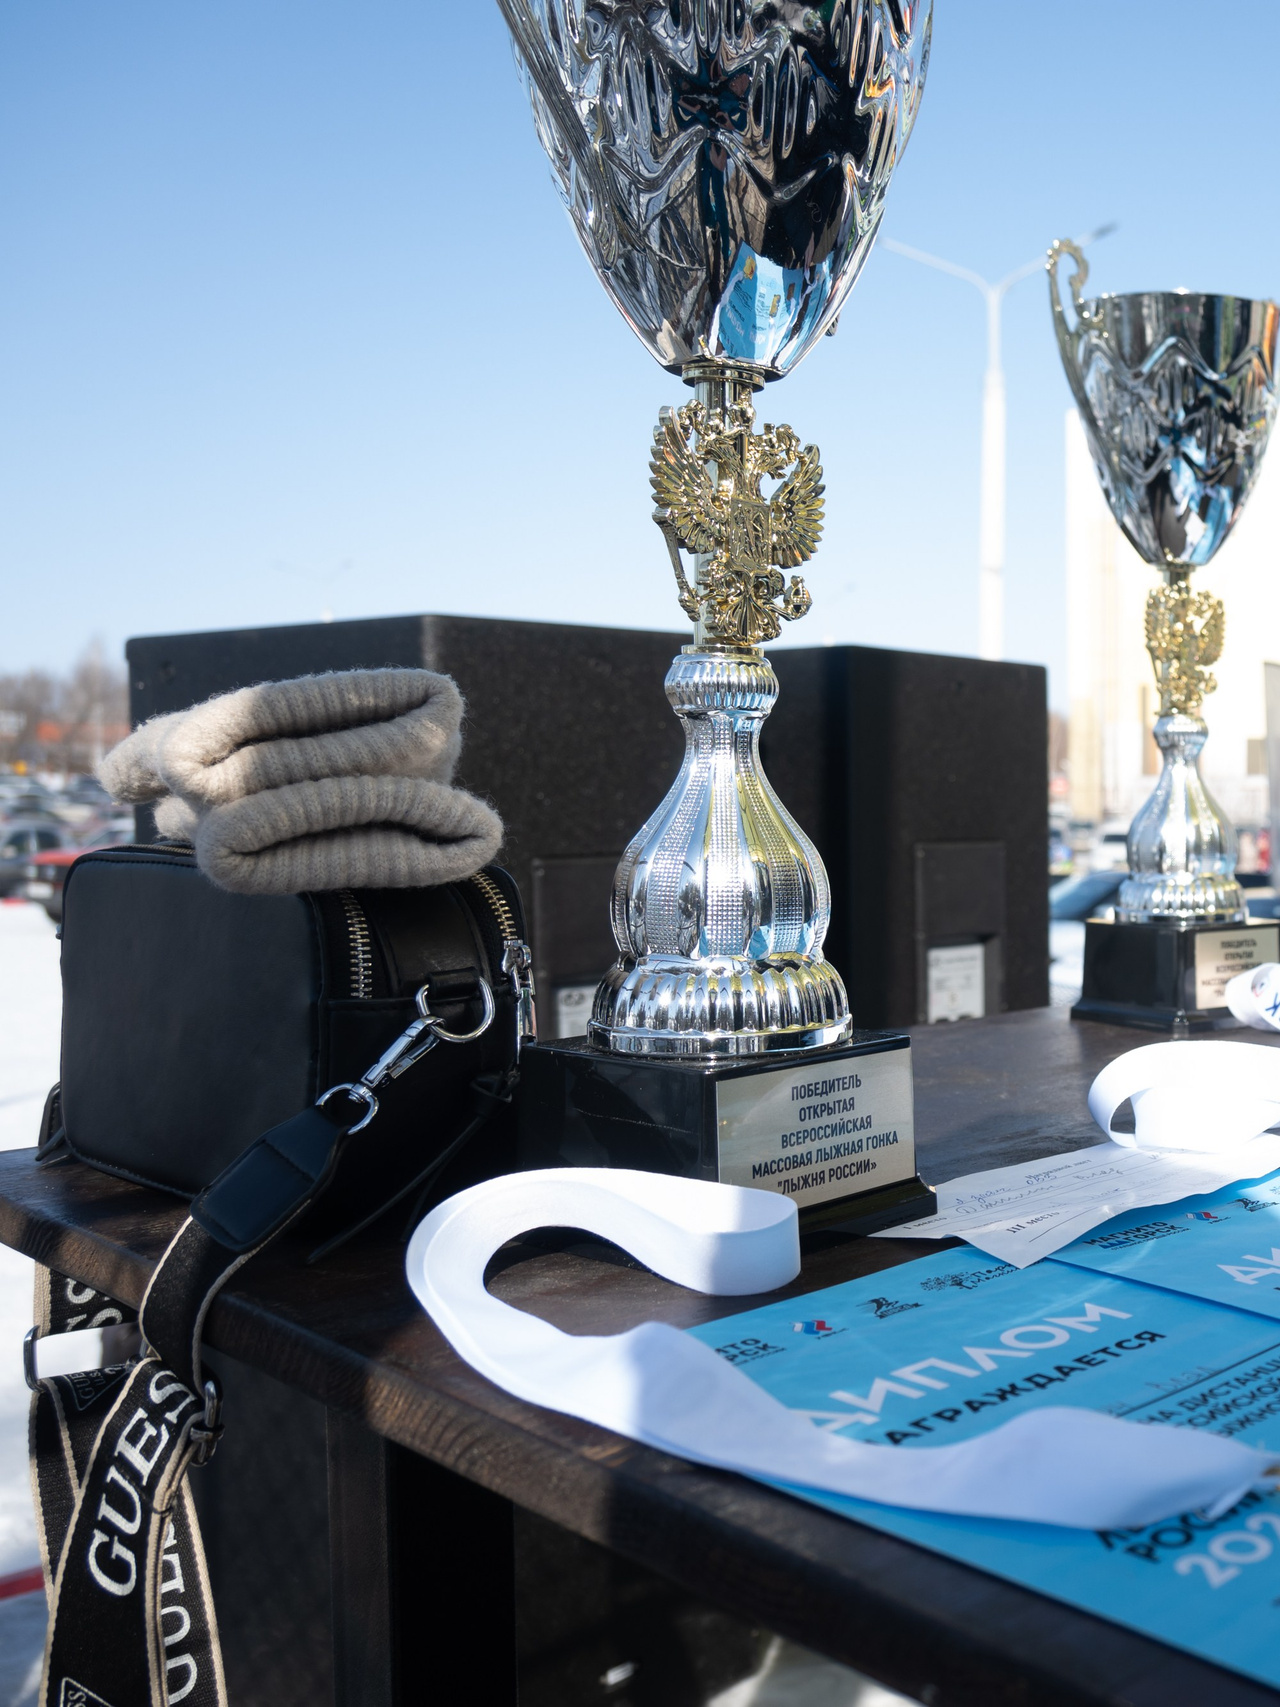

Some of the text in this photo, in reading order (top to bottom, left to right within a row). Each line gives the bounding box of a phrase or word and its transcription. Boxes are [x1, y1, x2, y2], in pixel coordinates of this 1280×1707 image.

[791, 1074, 861, 1101] ПОБЕДИТЕЛЬ
[799, 1097, 855, 1122] ОТКРЫТАЯ
[781, 1115, 872, 1149] ВСЕРОССИЙСКАЯ
[752, 1130, 899, 1180] МАССОВАЯ ЛЫЖНАЯ ГОНКА
[1082, 1221, 1168, 1246] МАГНИТО
[70, 1372, 95, 1399] GUE
[864, 1330, 1167, 1446] АГРАЖДАЕТСЯ
[87, 1369, 199, 1597] GUES
